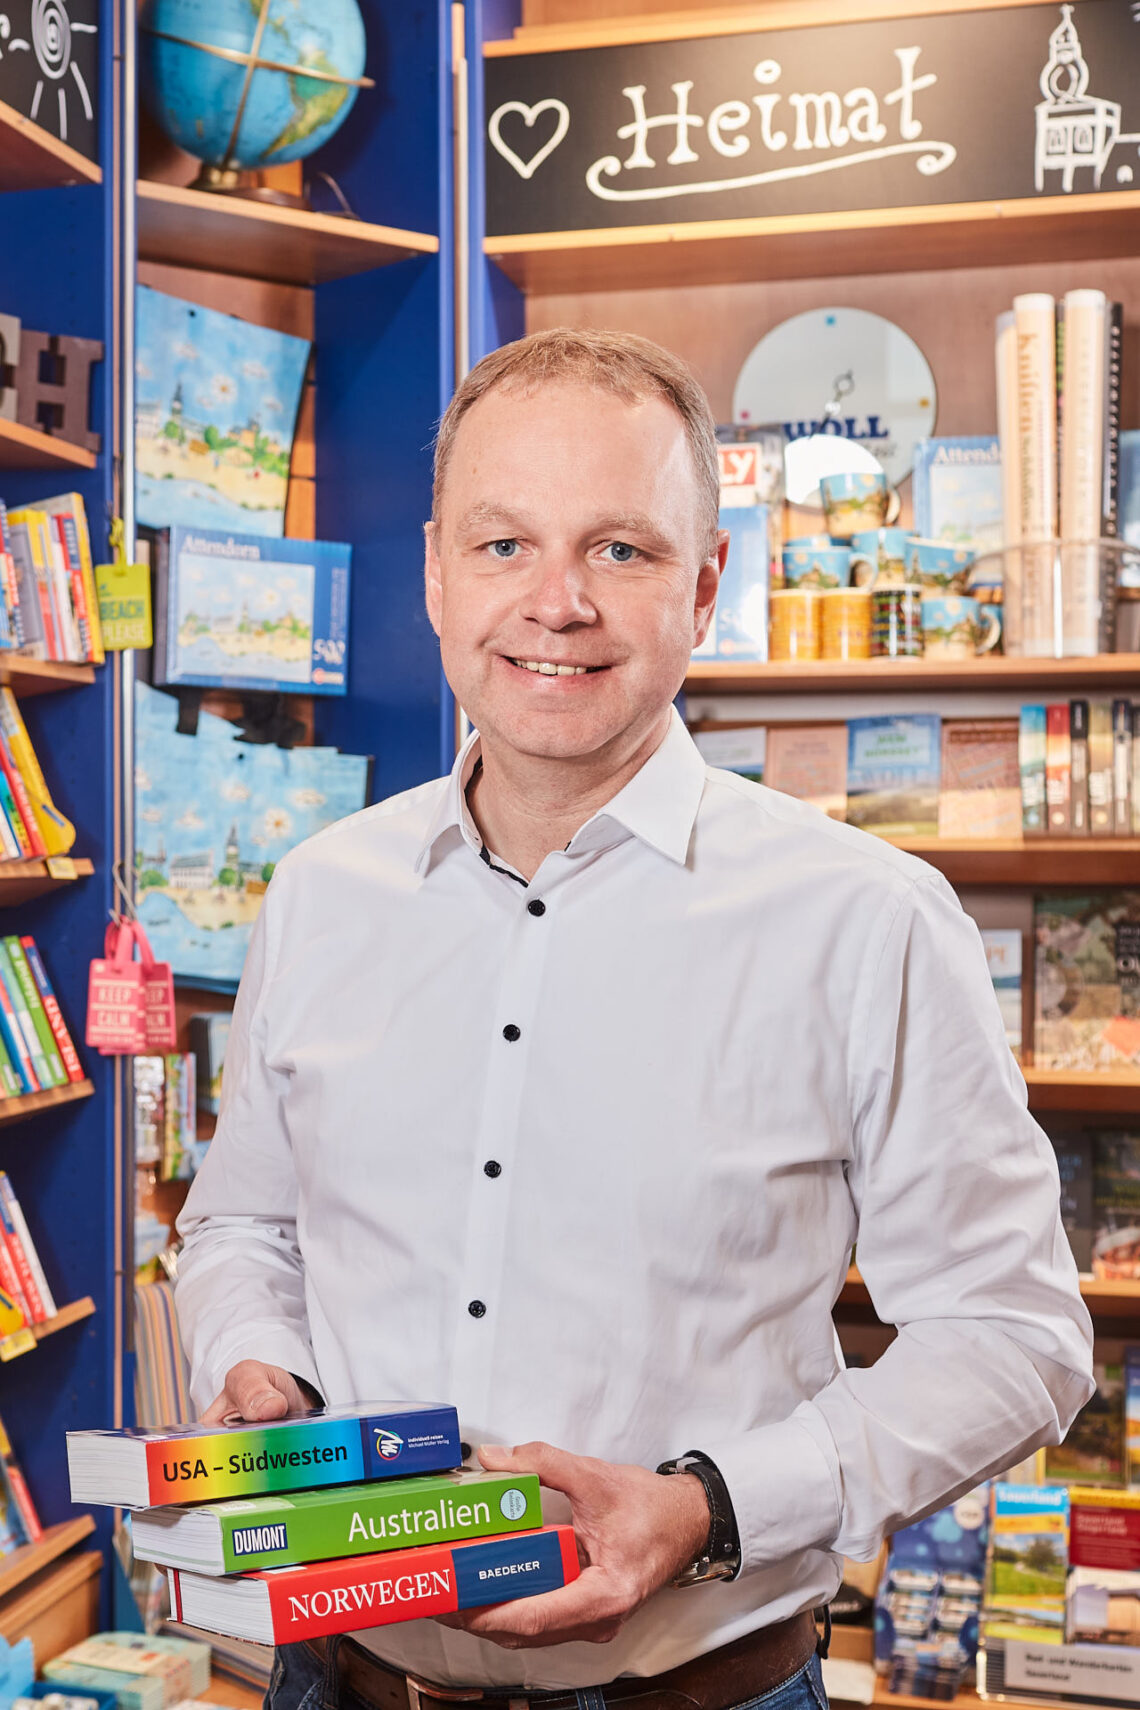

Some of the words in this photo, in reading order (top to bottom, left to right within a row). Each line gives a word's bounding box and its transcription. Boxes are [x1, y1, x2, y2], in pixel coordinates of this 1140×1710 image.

[617, 46, 937, 168] Heimat
[783, 416, 889, 442] WOLL
[935, 442, 1000, 464] Attend
[98, 988, 131, 1003] KEEP
[97, 1011, 130, 1027] CALM
[43, 997, 81, 1073] ISLAND
[163, 1459, 209, 1482] USA
[229, 1445, 348, 1475] Südwesten
[998, 1489, 1061, 1505] Sauerland
[348, 1498, 491, 1543] Australien
[233, 1525, 286, 1555] DUMONT
[478, 1560, 540, 1580] BAEDEKER
[288, 1569, 451, 1622] NORWEGEN
